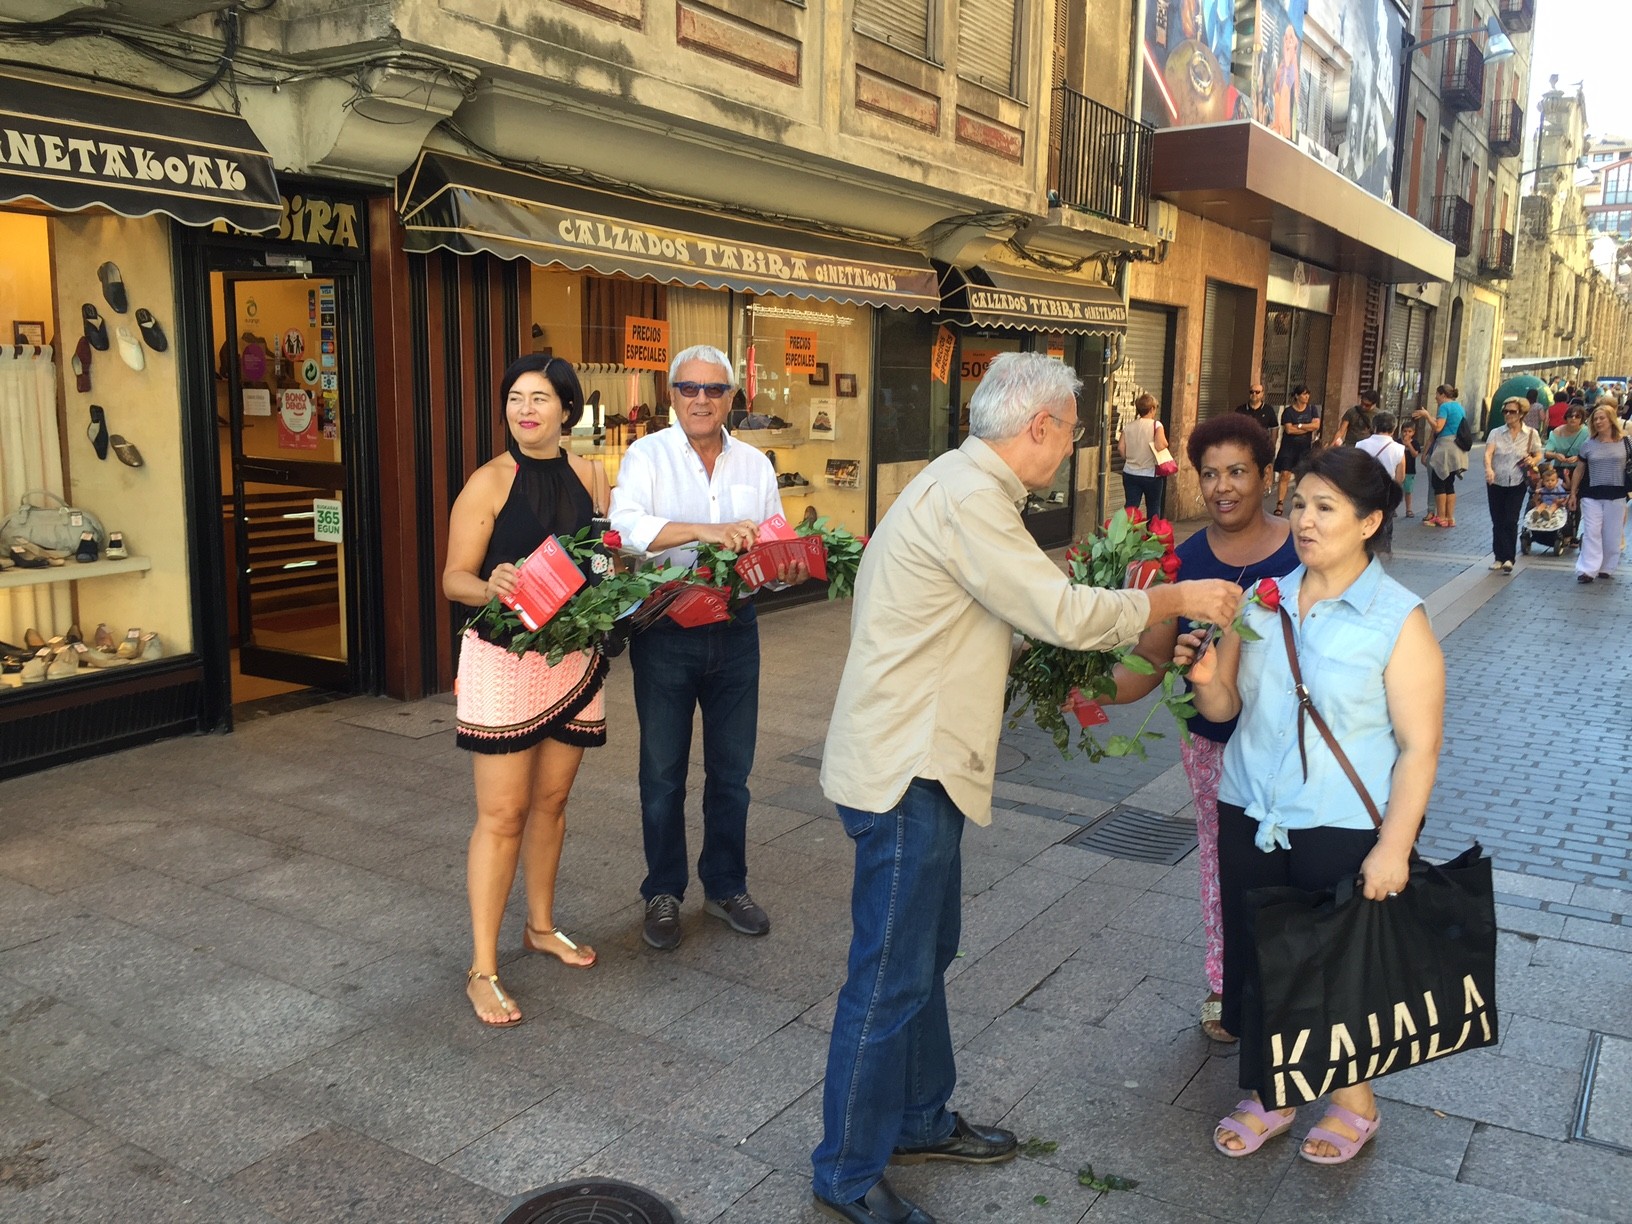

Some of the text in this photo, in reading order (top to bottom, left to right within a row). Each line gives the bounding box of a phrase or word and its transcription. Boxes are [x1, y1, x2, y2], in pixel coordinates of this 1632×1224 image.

[0, 128, 246, 191] NETAKOAK
[558, 218, 690, 262] CALZADOS
[971, 292, 1028, 312] CALZADOS
[632, 324, 661, 343] PRECIOS
[790, 335, 811, 350] PRECIOS
[626, 343, 667, 363] ESPECIALES
[785, 352, 815, 367] ESPECIALES
[285, 392, 307, 402] BONO
[285, 402, 307, 410] DENDA
[317, 510, 340, 525] 365
[317, 524, 340, 534] EGUN
